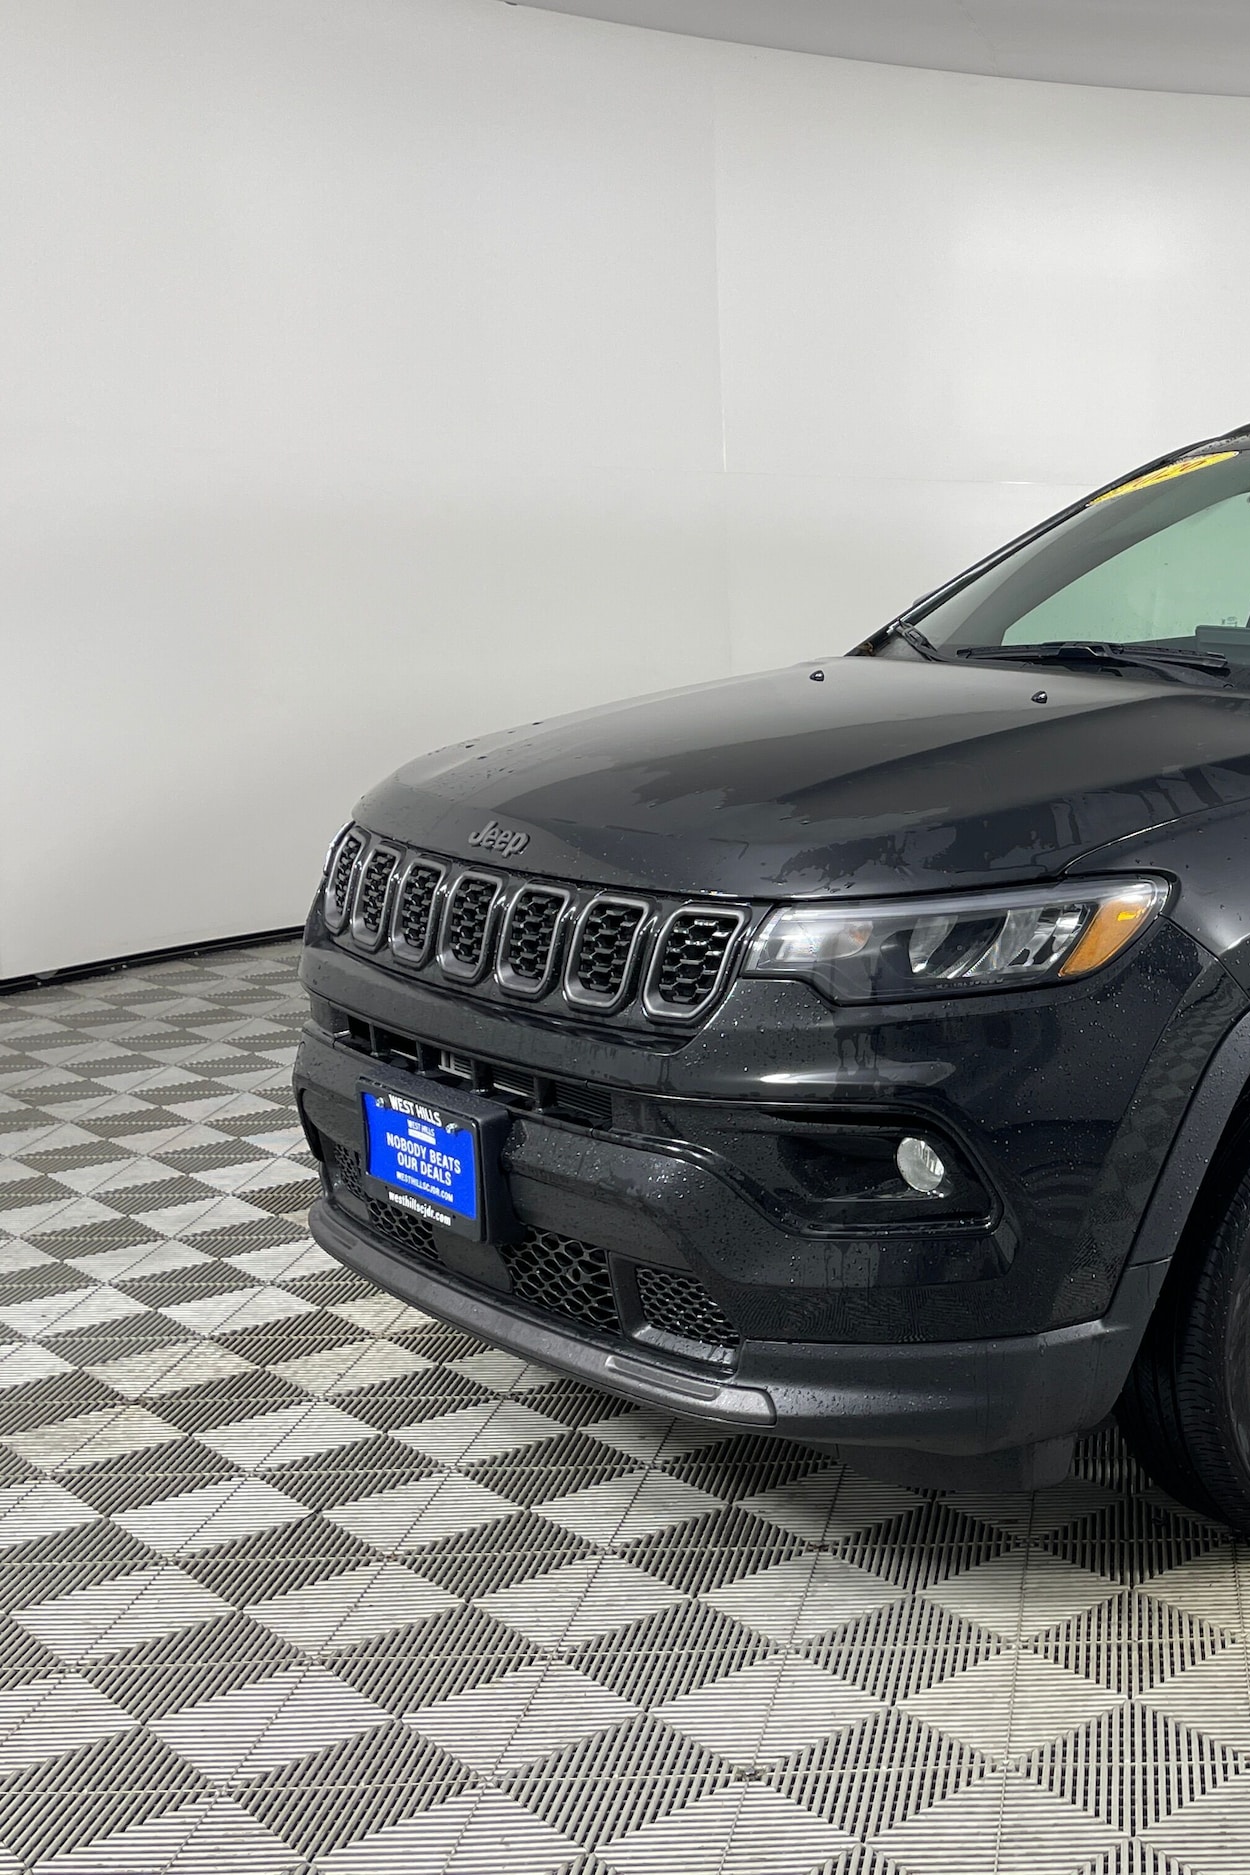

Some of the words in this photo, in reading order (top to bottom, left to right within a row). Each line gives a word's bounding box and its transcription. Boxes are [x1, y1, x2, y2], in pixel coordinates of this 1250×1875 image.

[468, 820, 530, 858] Jeep
[388, 1093, 415, 1116] WEST
[415, 1104, 443, 1128] HILLS
[406, 1119, 420, 1131] WEST
[421, 1124, 435, 1137] HILLS
[386, 1131, 427, 1160] NOBODY
[429, 1149, 461, 1175] BEATS
[397, 1151, 419, 1173] OUR
[420, 1160, 452, 1187] DEALS
[396, 1170, 454, 1203] WESTHILLSCJDR.COM
[388, 1191, 452, 1227] westhillscjdr.com
